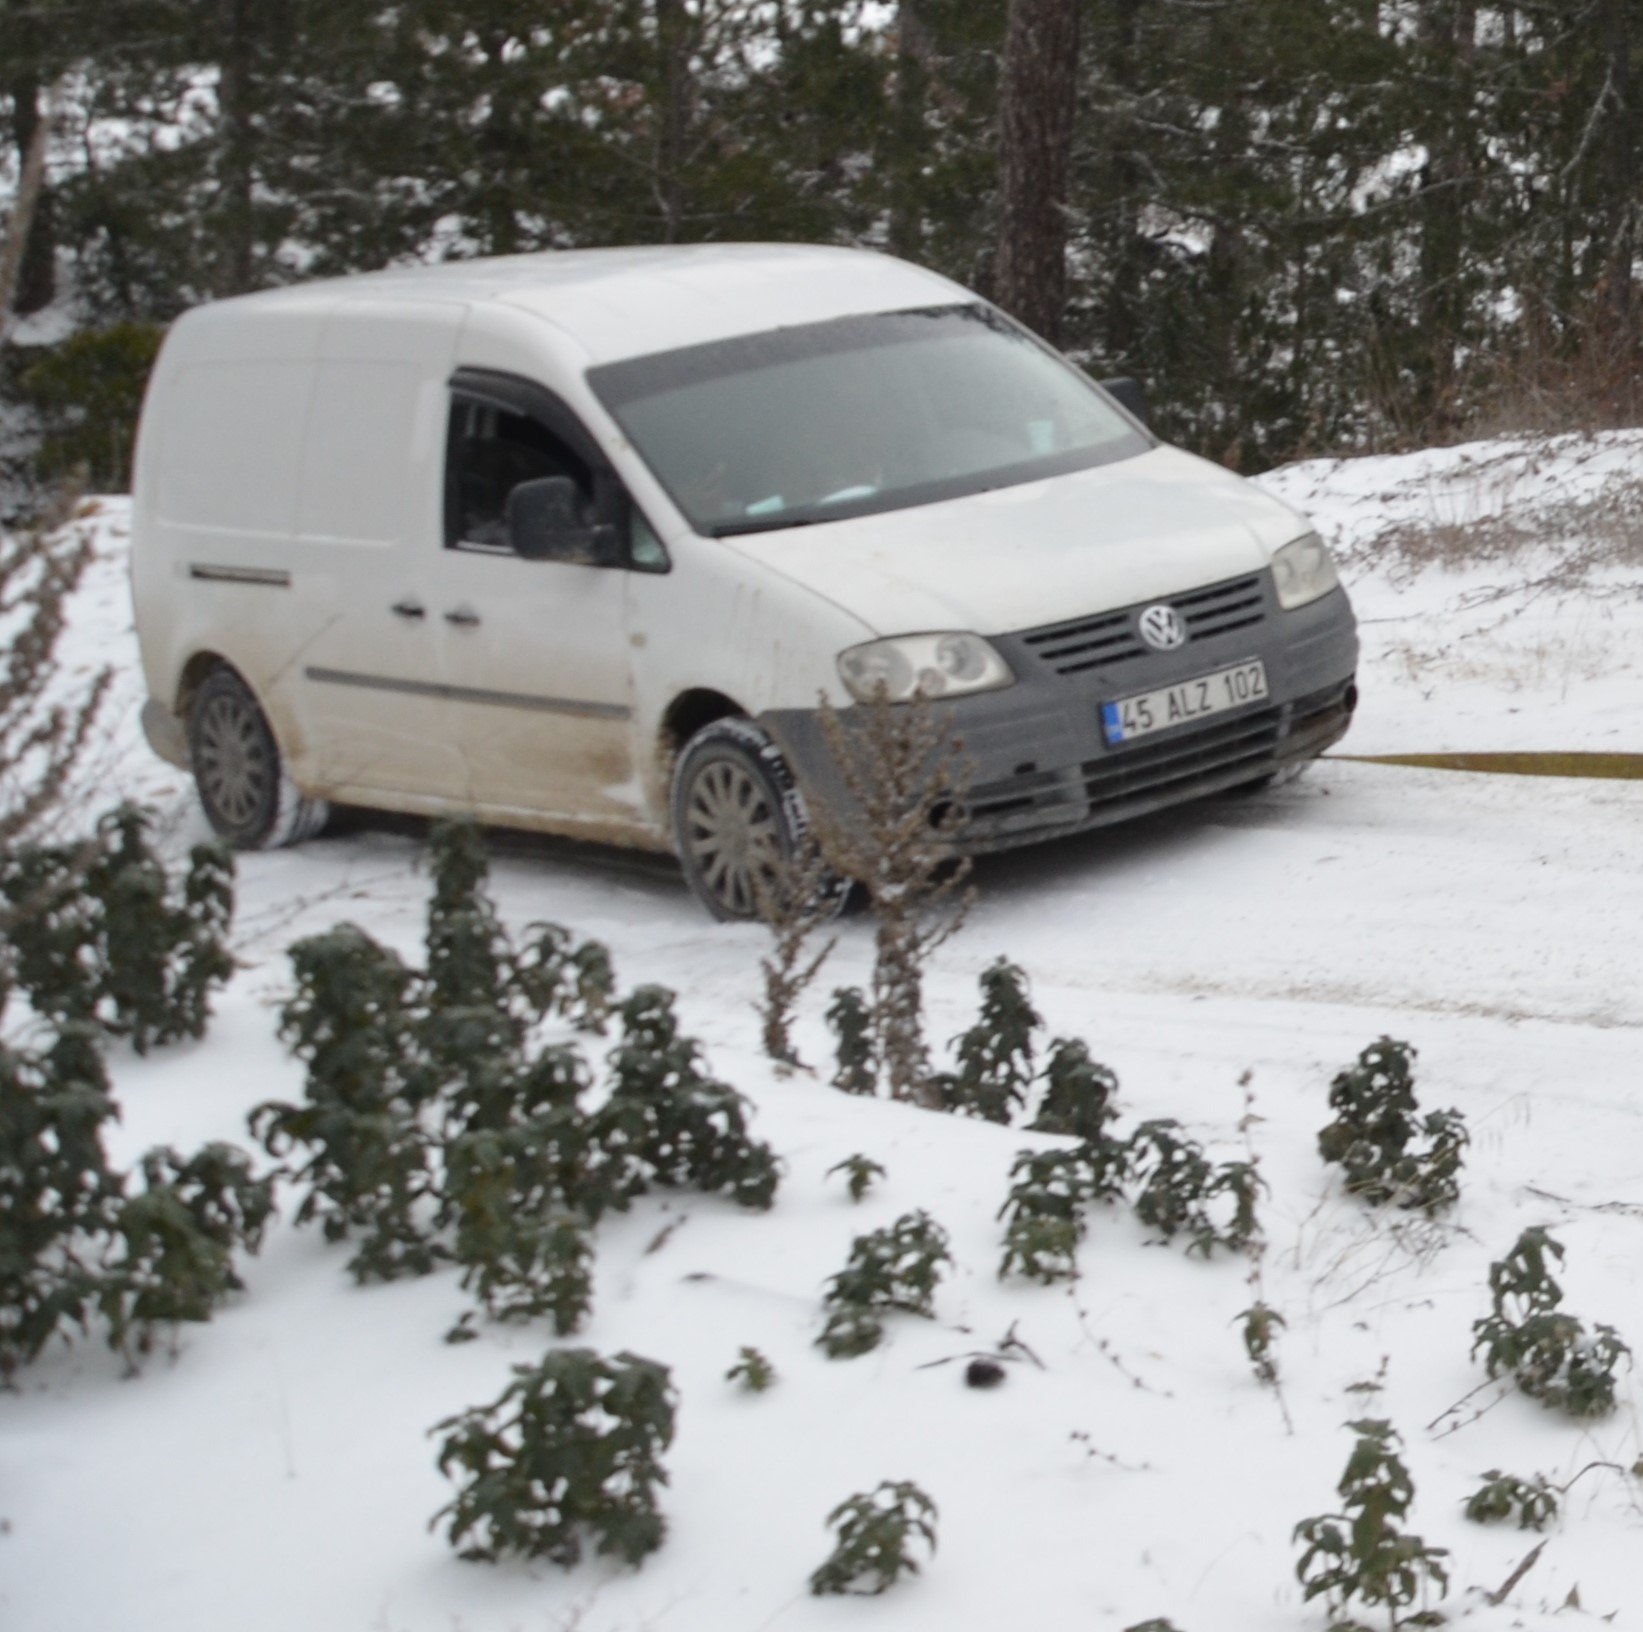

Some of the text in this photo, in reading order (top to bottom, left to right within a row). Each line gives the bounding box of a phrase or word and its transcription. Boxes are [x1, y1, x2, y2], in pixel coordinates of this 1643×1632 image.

[1121, 666, 1263, 733] 45 ALZ 102
